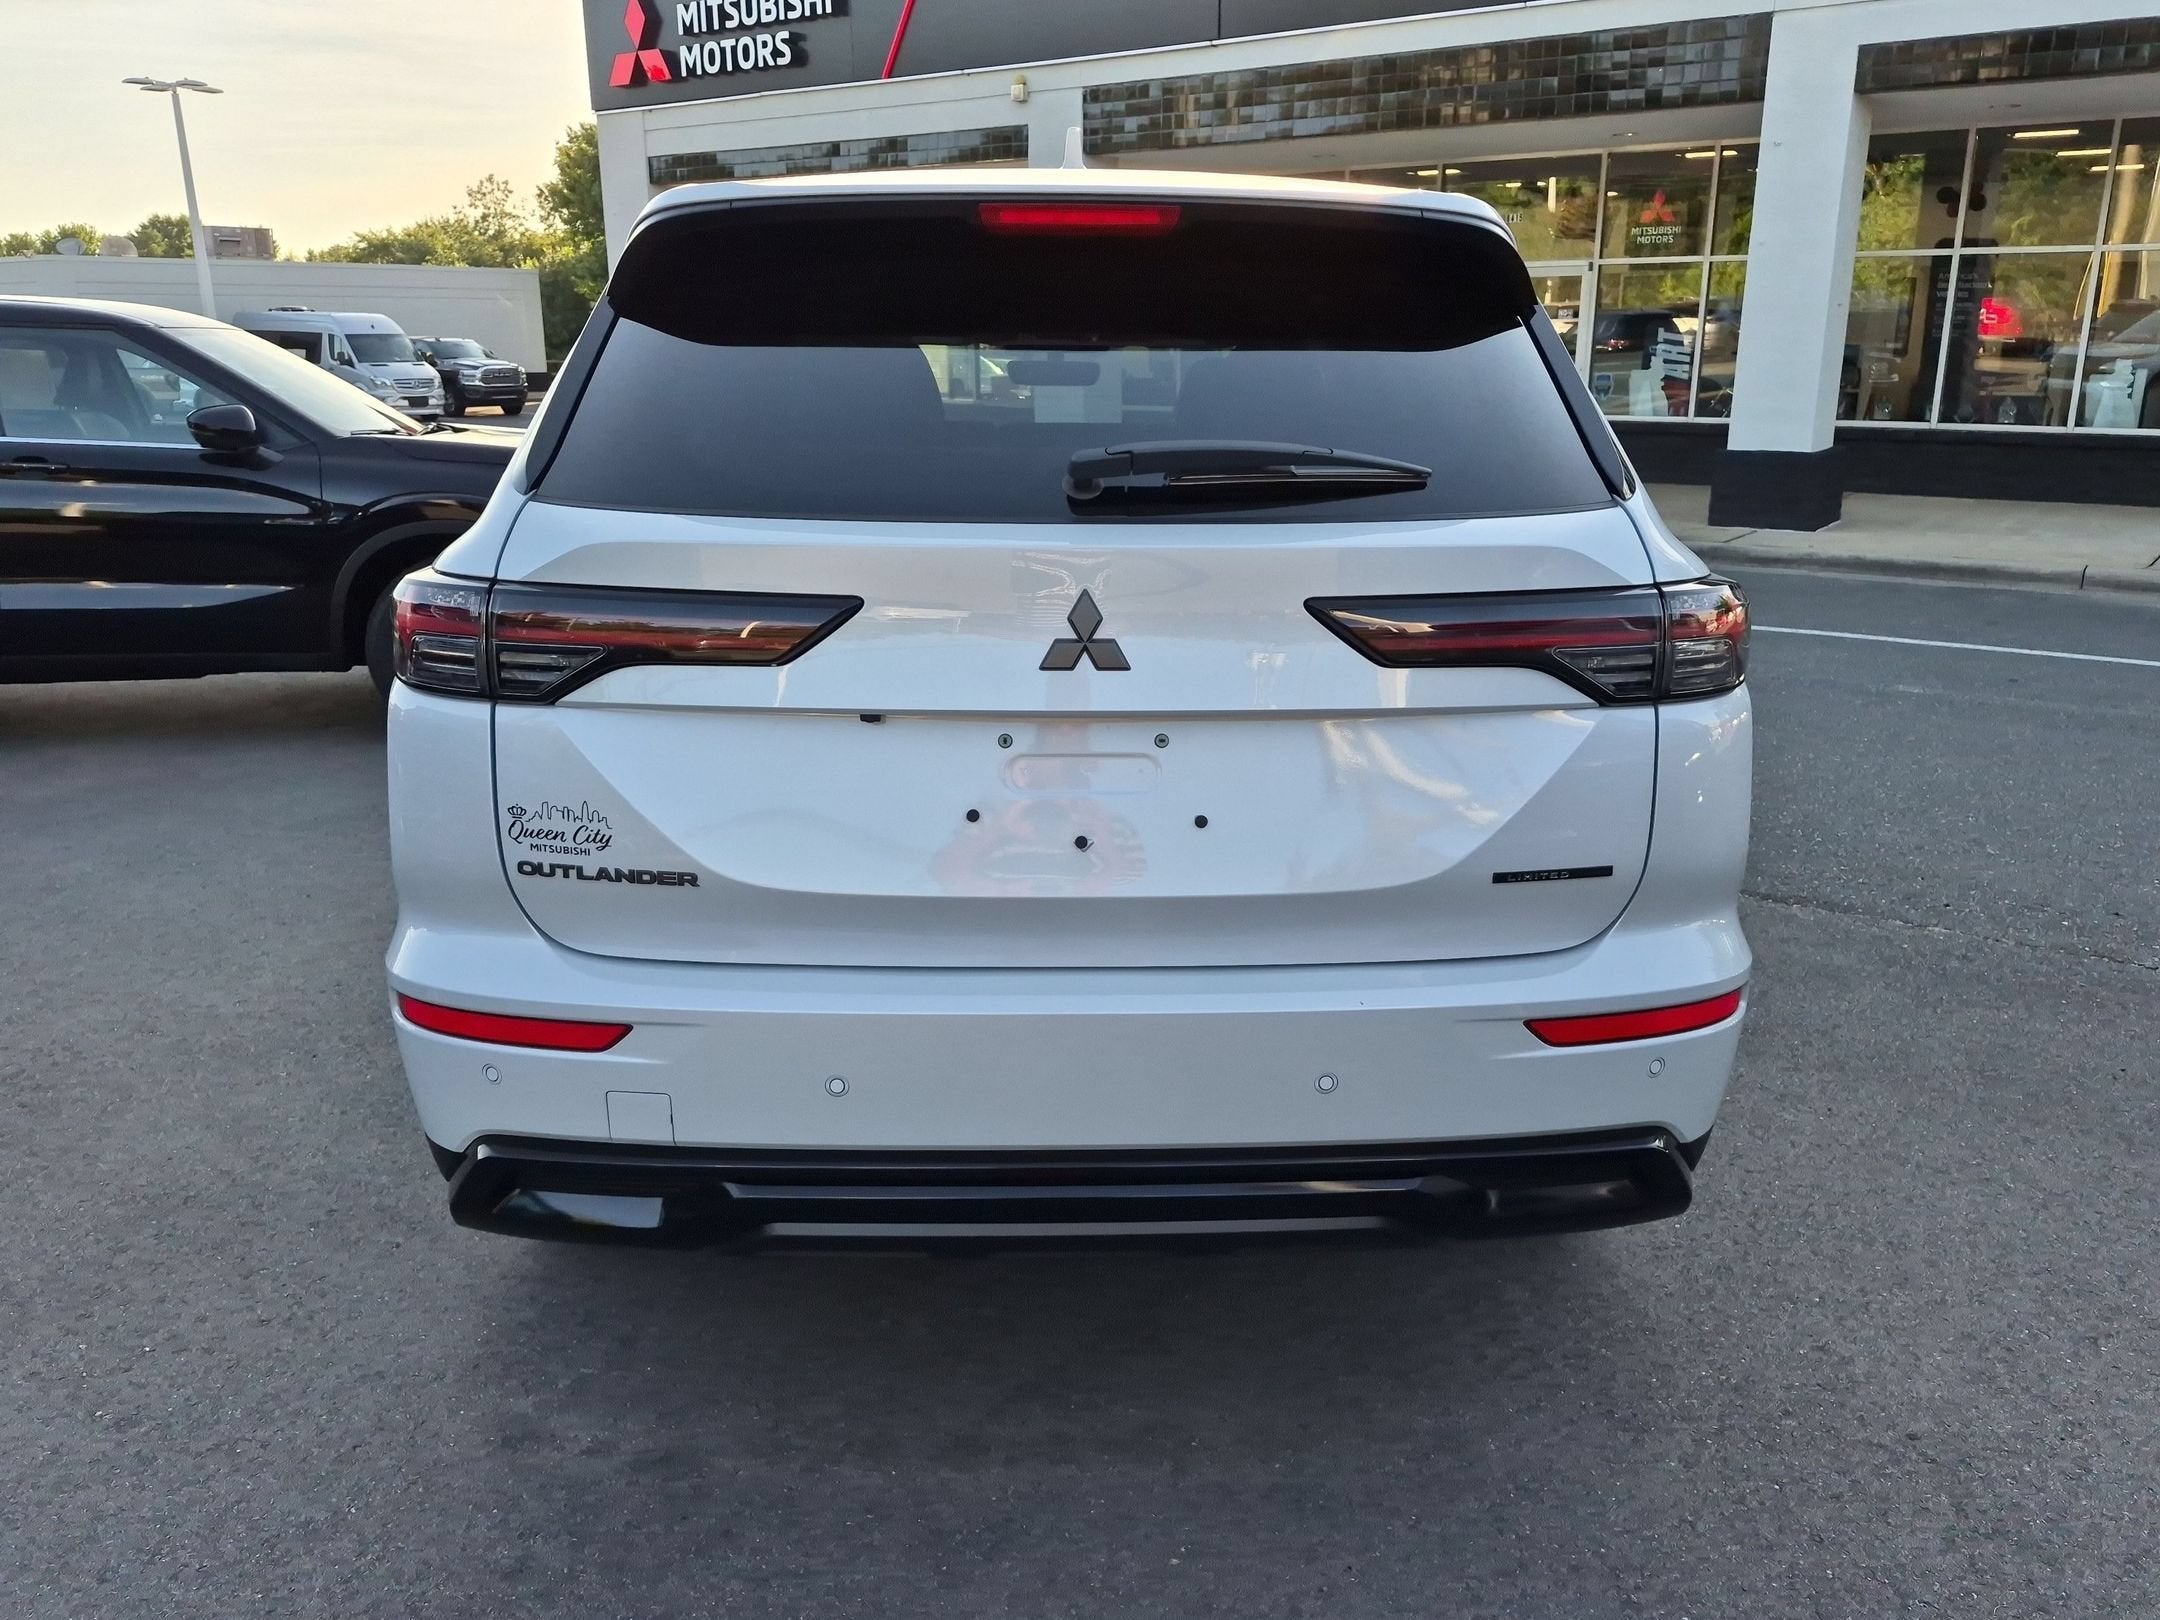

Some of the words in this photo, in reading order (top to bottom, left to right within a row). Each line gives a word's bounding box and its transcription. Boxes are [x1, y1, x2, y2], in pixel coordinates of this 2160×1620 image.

[679, 30, 792, 78] MOTORS
[1631, 225, 1682, 236] MITSUBISHI
[1636, 234, 1675, 244] MOTORS
[507, 819, 567, 844] Queen
[572, 824, 613, 851] City
[530, 842, 591, 857] MITSUBISHI
[517, 860, 700, 888] OUTLANDER
[1506, 871, 1570, 882] LIMITED
